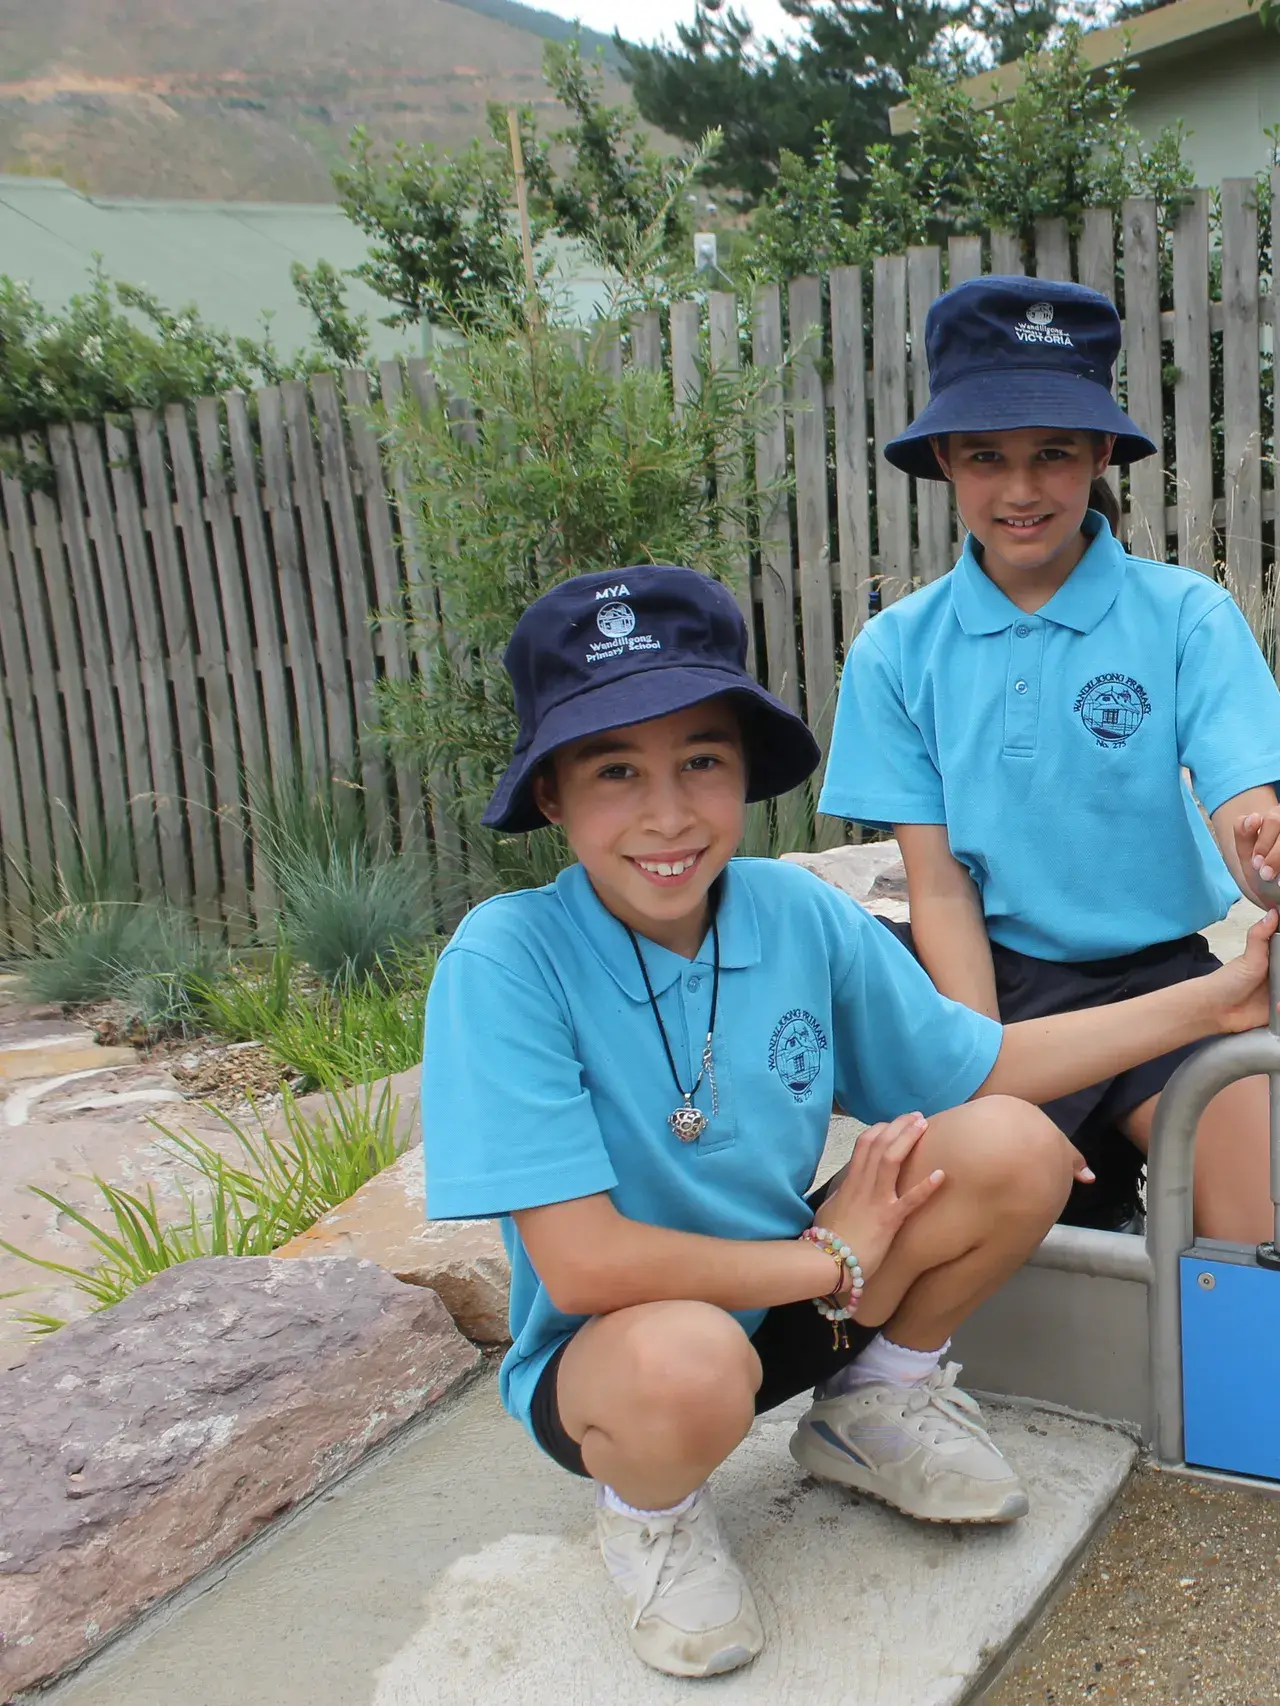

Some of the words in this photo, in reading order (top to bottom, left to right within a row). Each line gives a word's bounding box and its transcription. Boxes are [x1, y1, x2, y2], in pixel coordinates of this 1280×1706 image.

[1015, 331, 1074, 347] VICTORIA
[595, 584, 630, 600] MYA
[585, 646, 623, 663] Primary
[628, 640, 661, 651] School
[589, 635, 652, 652] Wandiligong
[1073, 673, 1124, 713] WANDILIGONG
[1125, 676, 1152, 716] PRIMARY
[1112, 740, 1127, 749] 275
[802, 1010, 828, 1051] PRIMARY
